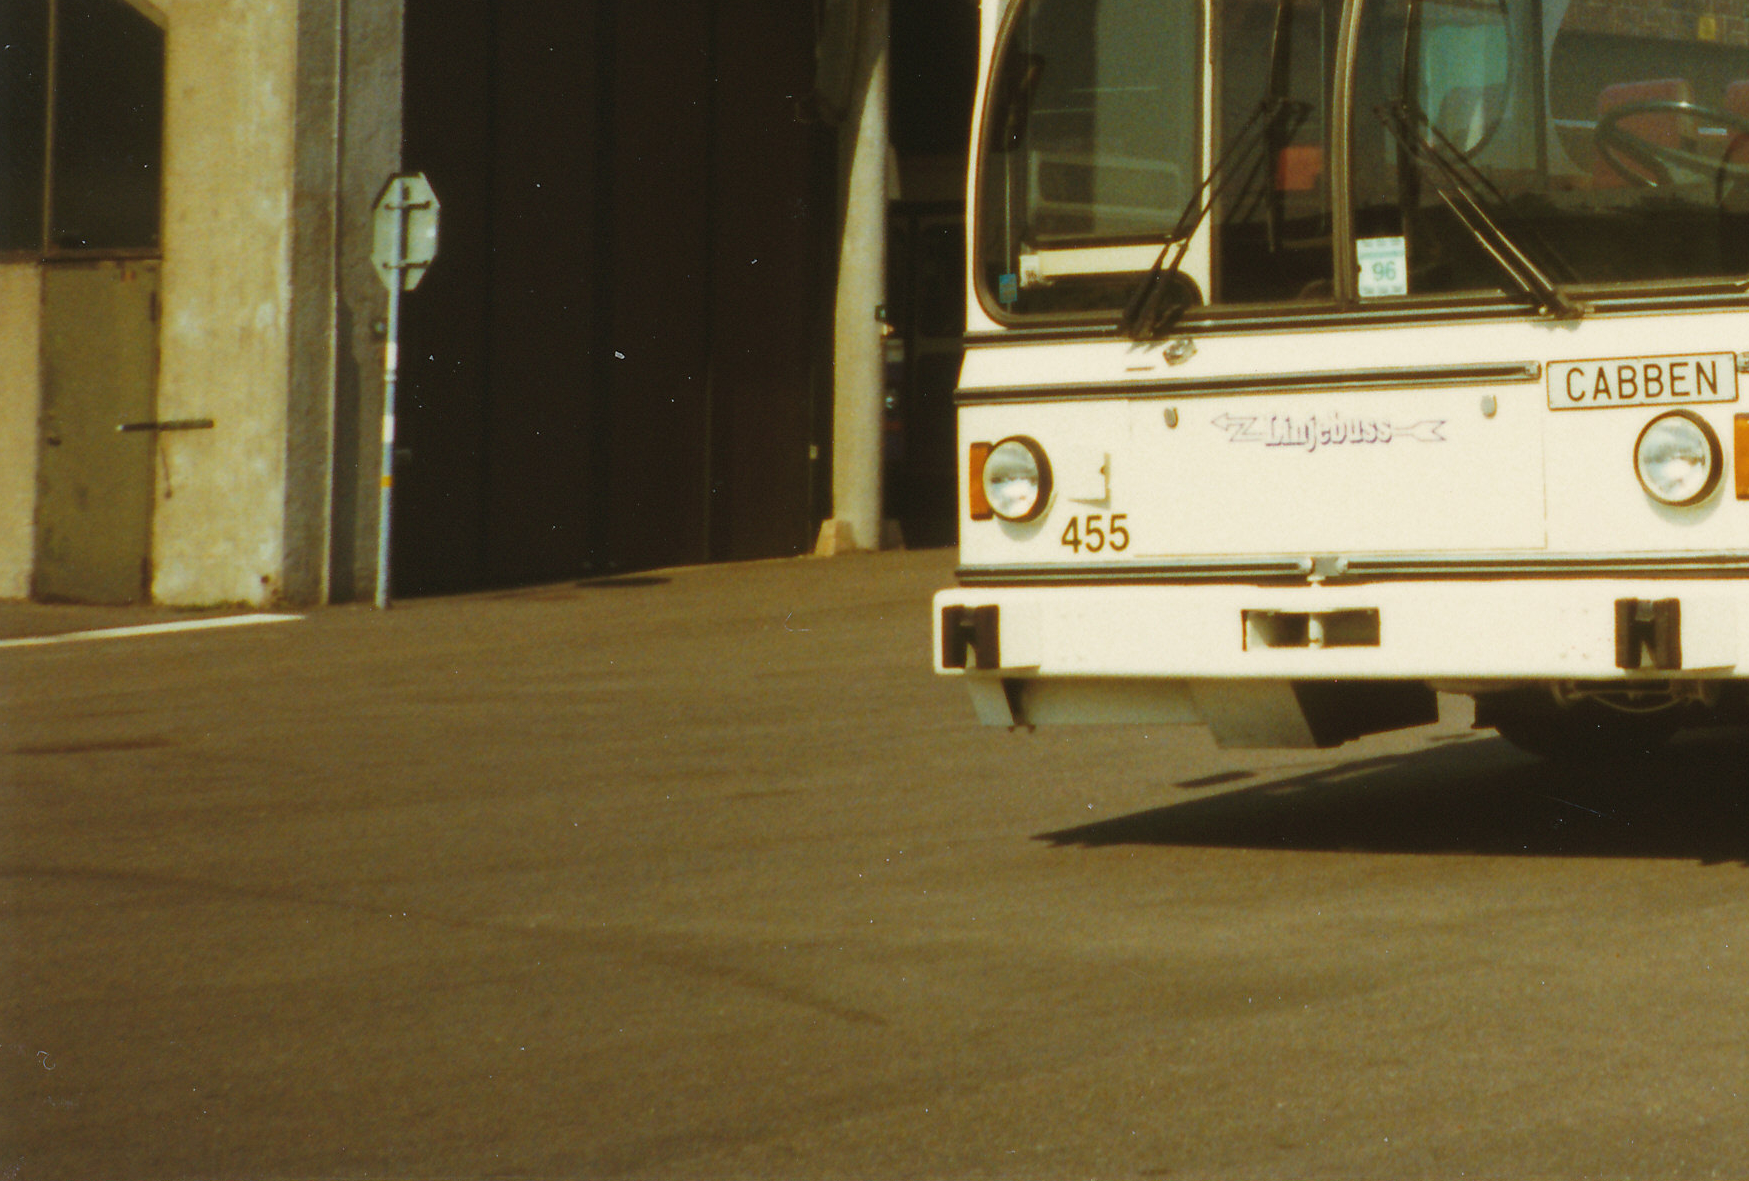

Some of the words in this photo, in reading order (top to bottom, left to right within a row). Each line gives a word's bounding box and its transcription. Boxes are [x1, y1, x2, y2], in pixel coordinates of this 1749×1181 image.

[1371, 261, 1396, 281] 96
[1566, 360, 1718, 402] CABBEN
[1264, 413, 1393, 453] Linjebuss
[1061, 514, 1130, 554] 455
